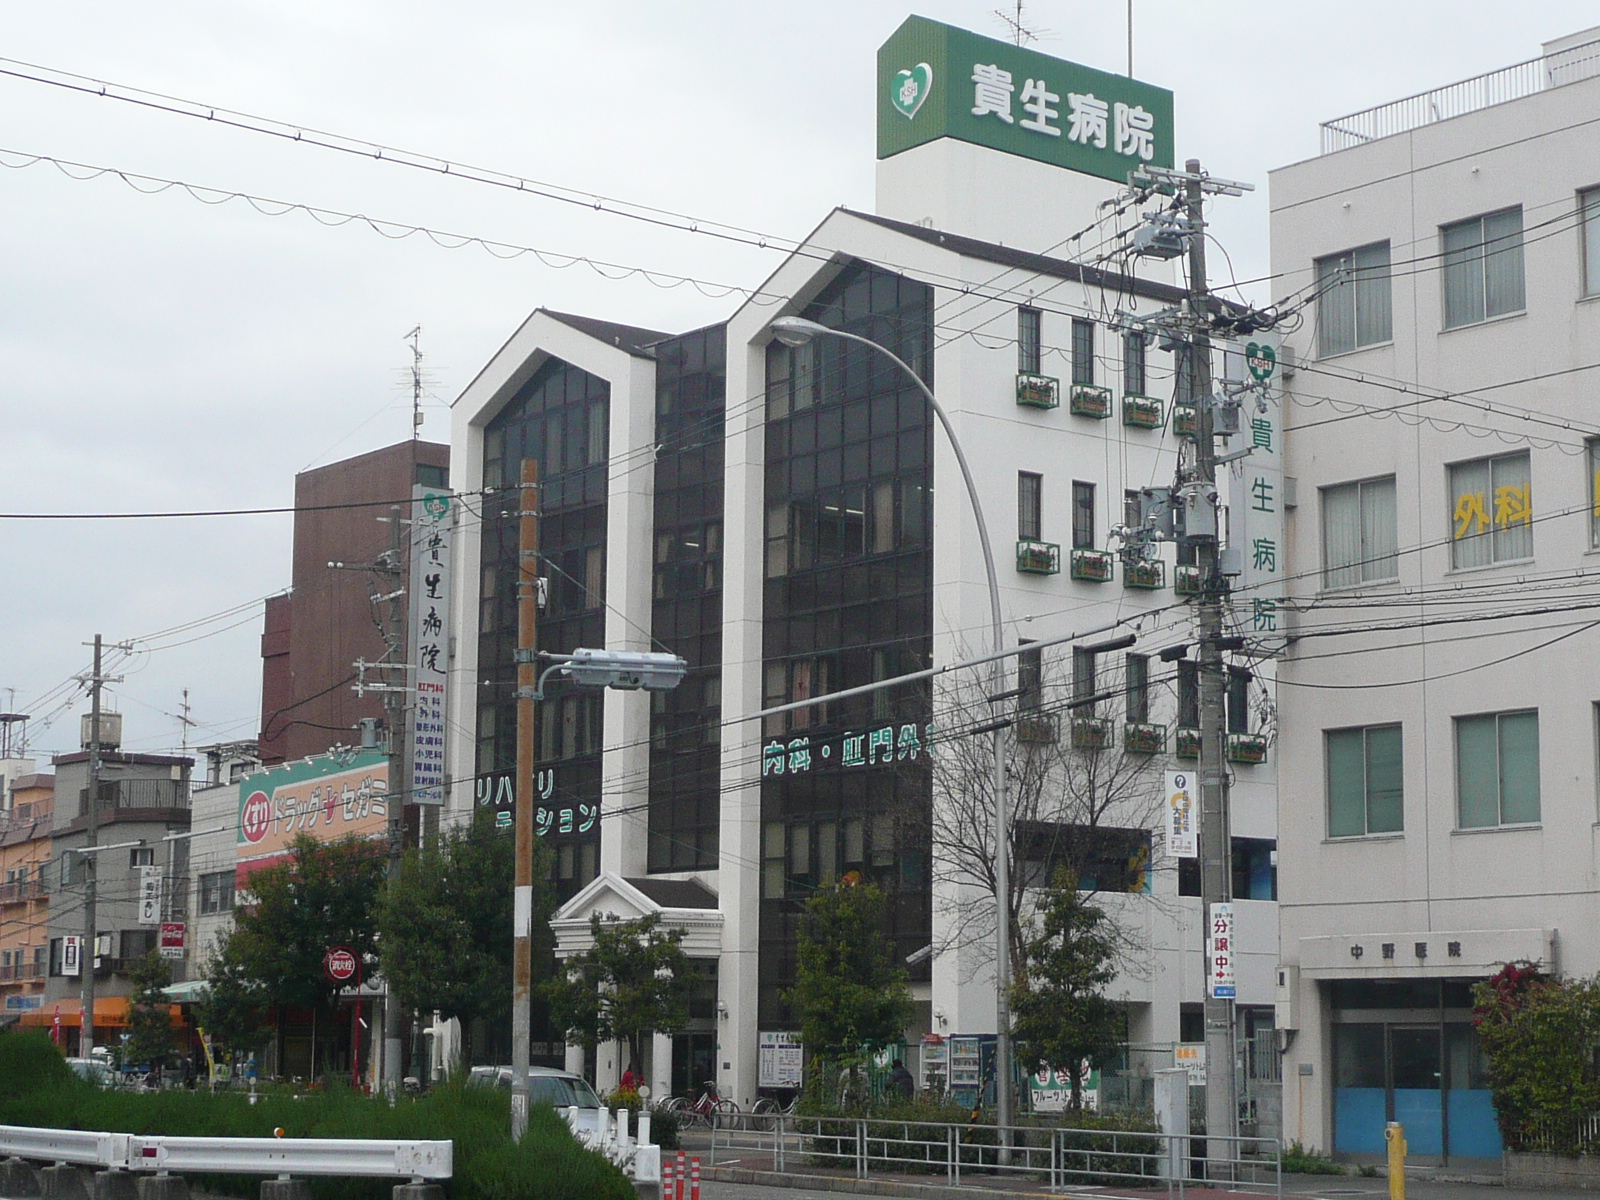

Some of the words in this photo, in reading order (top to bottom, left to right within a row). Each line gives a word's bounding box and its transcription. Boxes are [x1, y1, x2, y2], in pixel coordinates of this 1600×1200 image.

[901, 84, 918, 98] KSH
[971, 63, 1154, 161] 貴生病院
[1251, 356, 1271, 369] KSH
[1453, 482, 1532, 540] 外科
[1251, 417, 1276, 632] 貴生病院
[420, 530, 448, 675] 貴生病院
[417, 682, 444, 693] 肛門科
[419, 696, 441, 706] 内科
[419, 707, 441, 720] 外科
[416, 722, 444, 734] 整形外科
[415, 736, 443, 747] 皮膚科
[415, 749, 443, 760] 小児科
[478, 769, 553, 805] リハリ
[243, 801, 268, 834] くすり
[274, 787, 322, 836] ドラッグ
[341, 776, 387, 822] セガミ
[495, 803, 597, 836] テション
[1214, 919, 1229, 969] 分譲中
[331, 960, 353, 970] 消火栓
